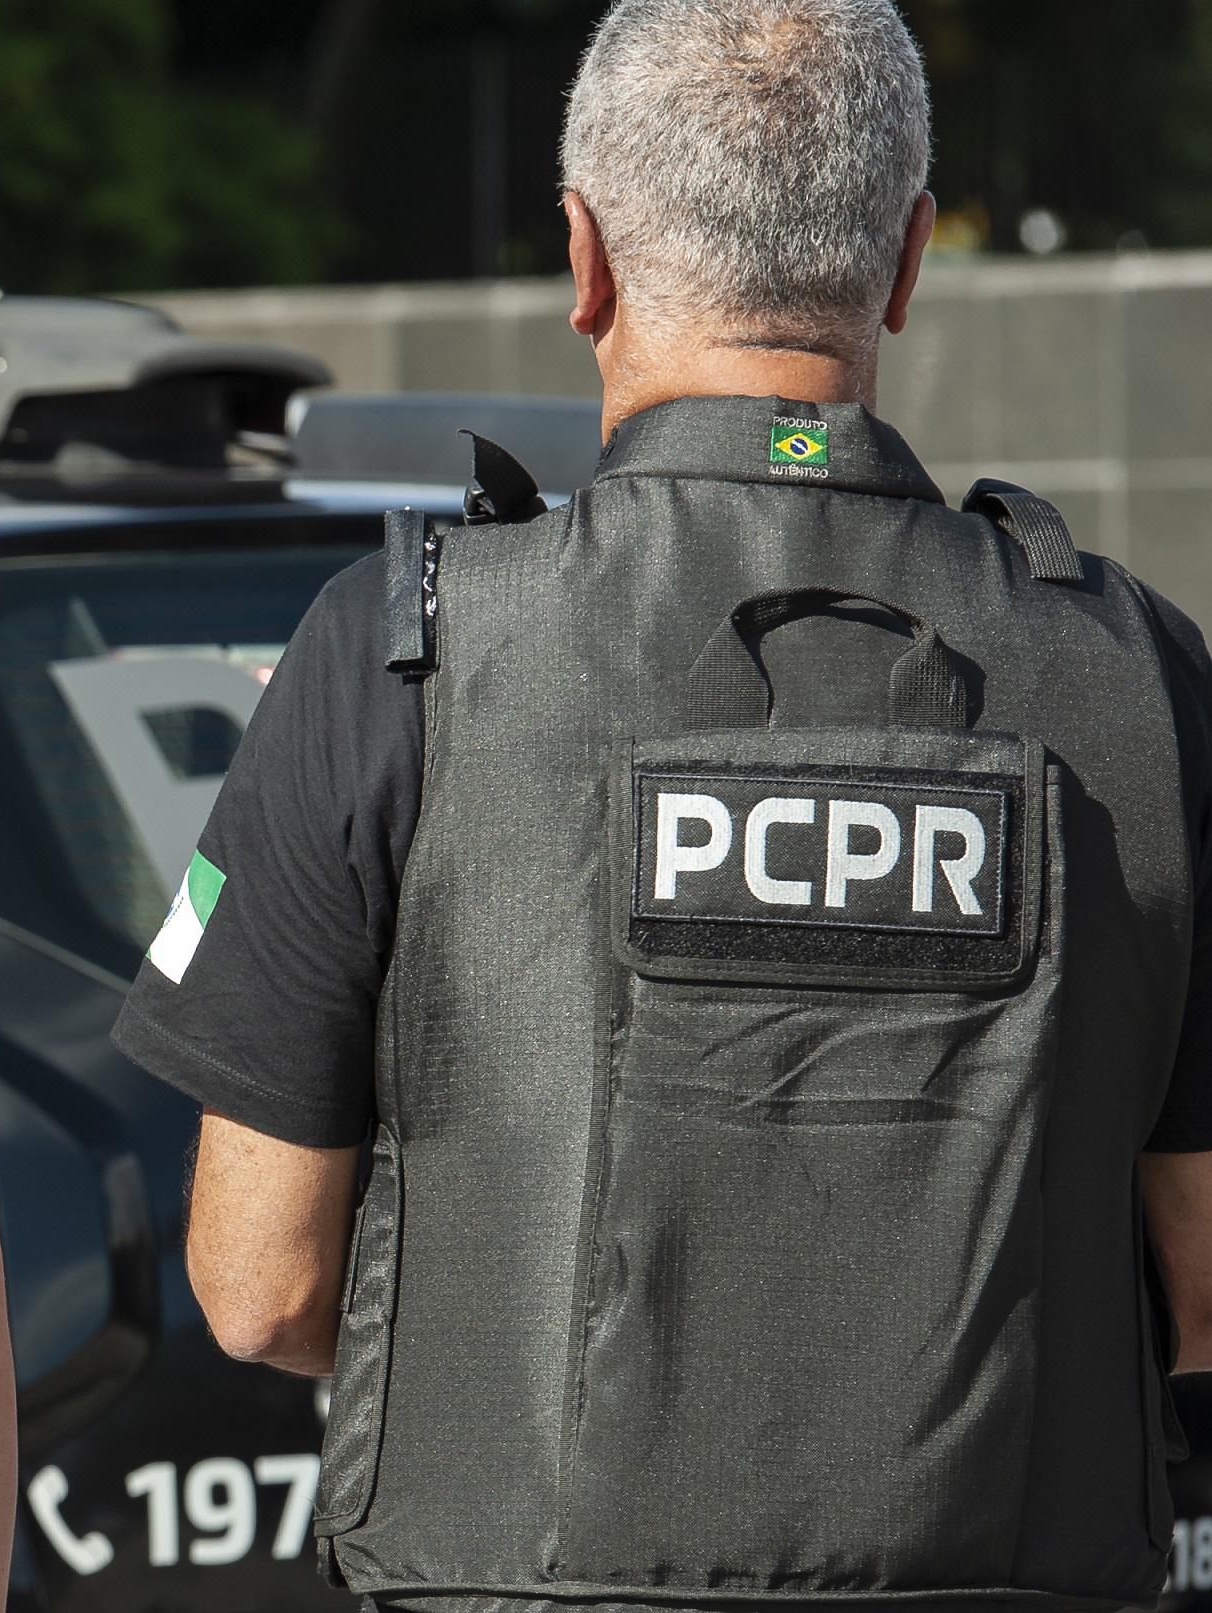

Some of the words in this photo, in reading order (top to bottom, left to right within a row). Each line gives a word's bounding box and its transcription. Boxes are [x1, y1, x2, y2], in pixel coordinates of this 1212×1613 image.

[773, 416, 828, 430] PRODUTO
[768, 463, 829, 478] AUTÊNTICO
[654, 793, 986, 915] PCPR
[124, 1453, 321, 1567] 197
